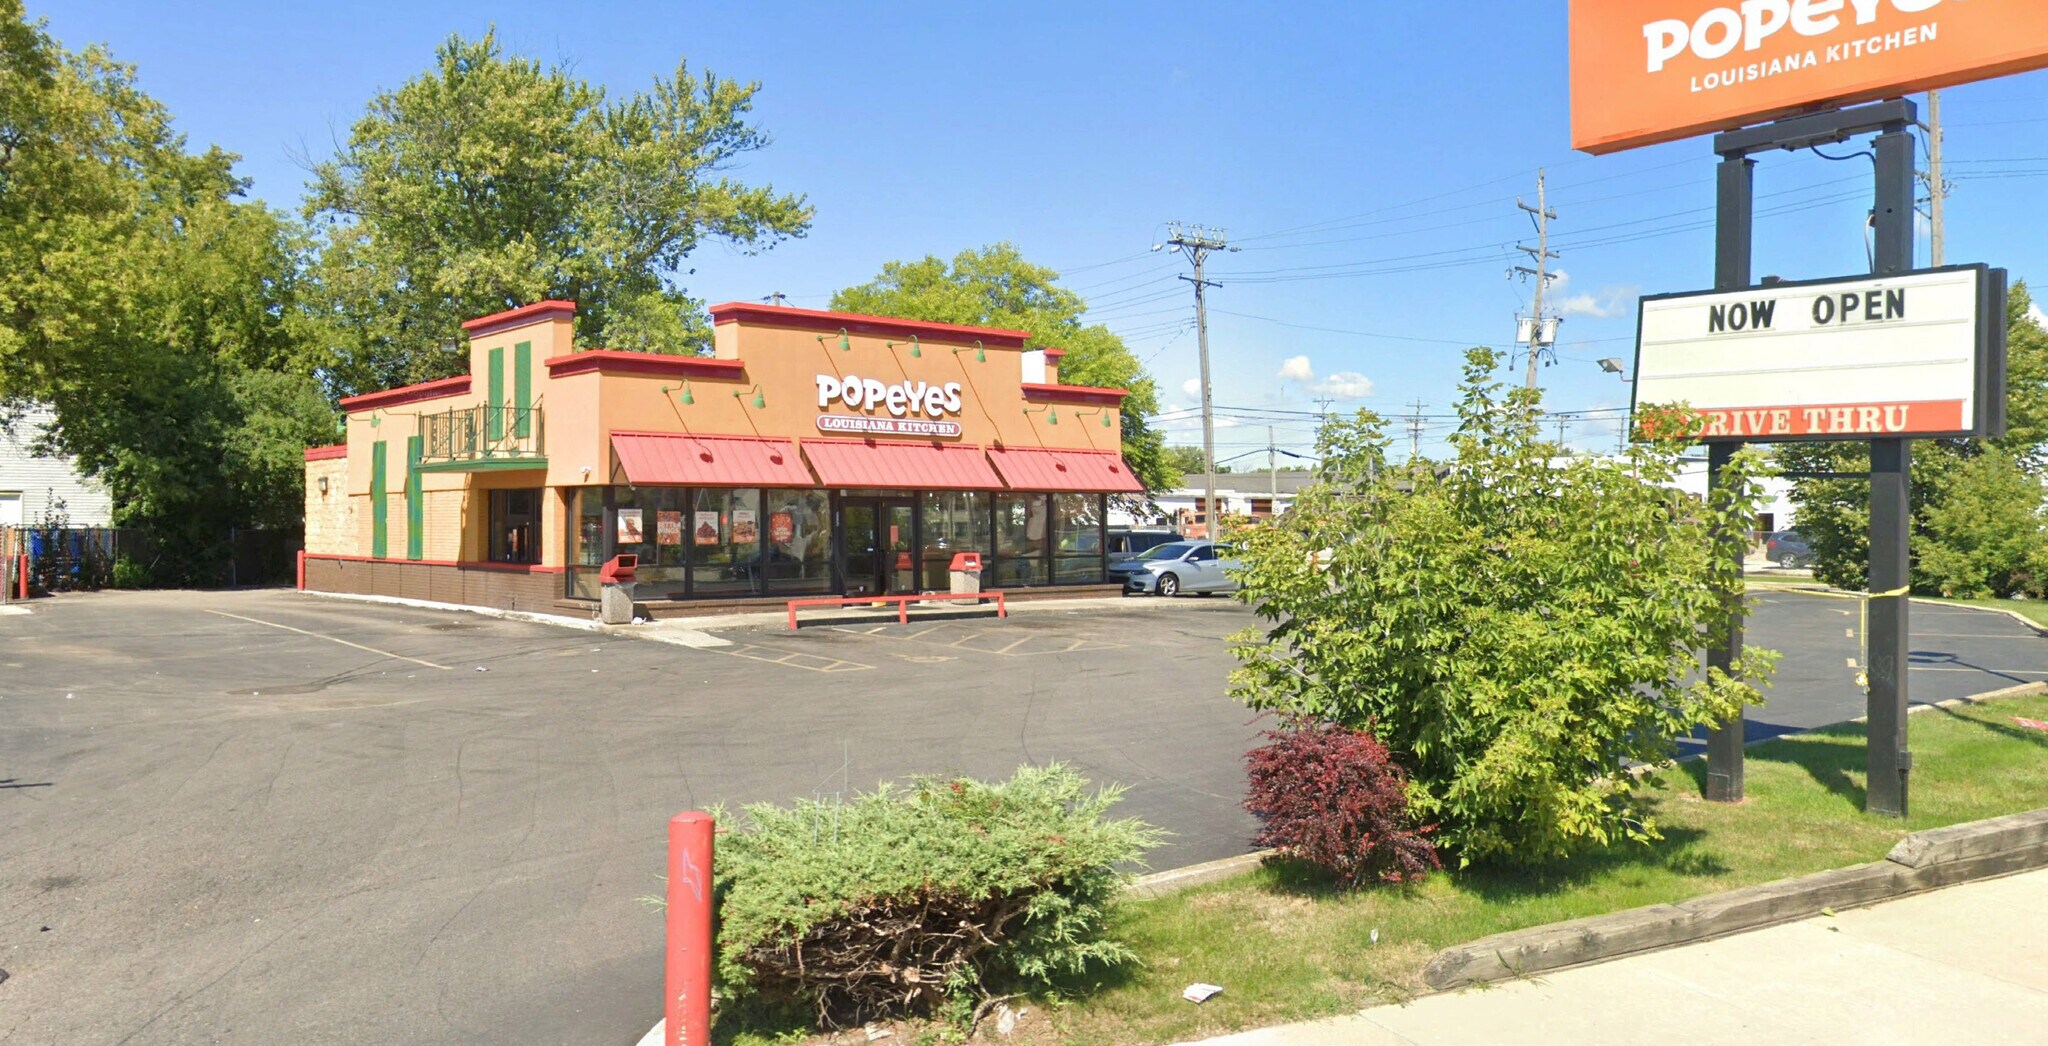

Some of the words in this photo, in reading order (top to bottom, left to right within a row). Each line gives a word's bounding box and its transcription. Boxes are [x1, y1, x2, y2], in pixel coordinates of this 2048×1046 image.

[1690, 50, 1817, 93] LOUISIANA
[1825, 22, 1938, 63] KITCHEN
[1708, 299, 1777, 333] NOW
[1812, 288, 1905, 325] OPEN
[824, 418, 894, 431] LOUISIANA
[897, 424, 955, 434] KITCHEN
[1802, 405, 1910, 432] THRU
